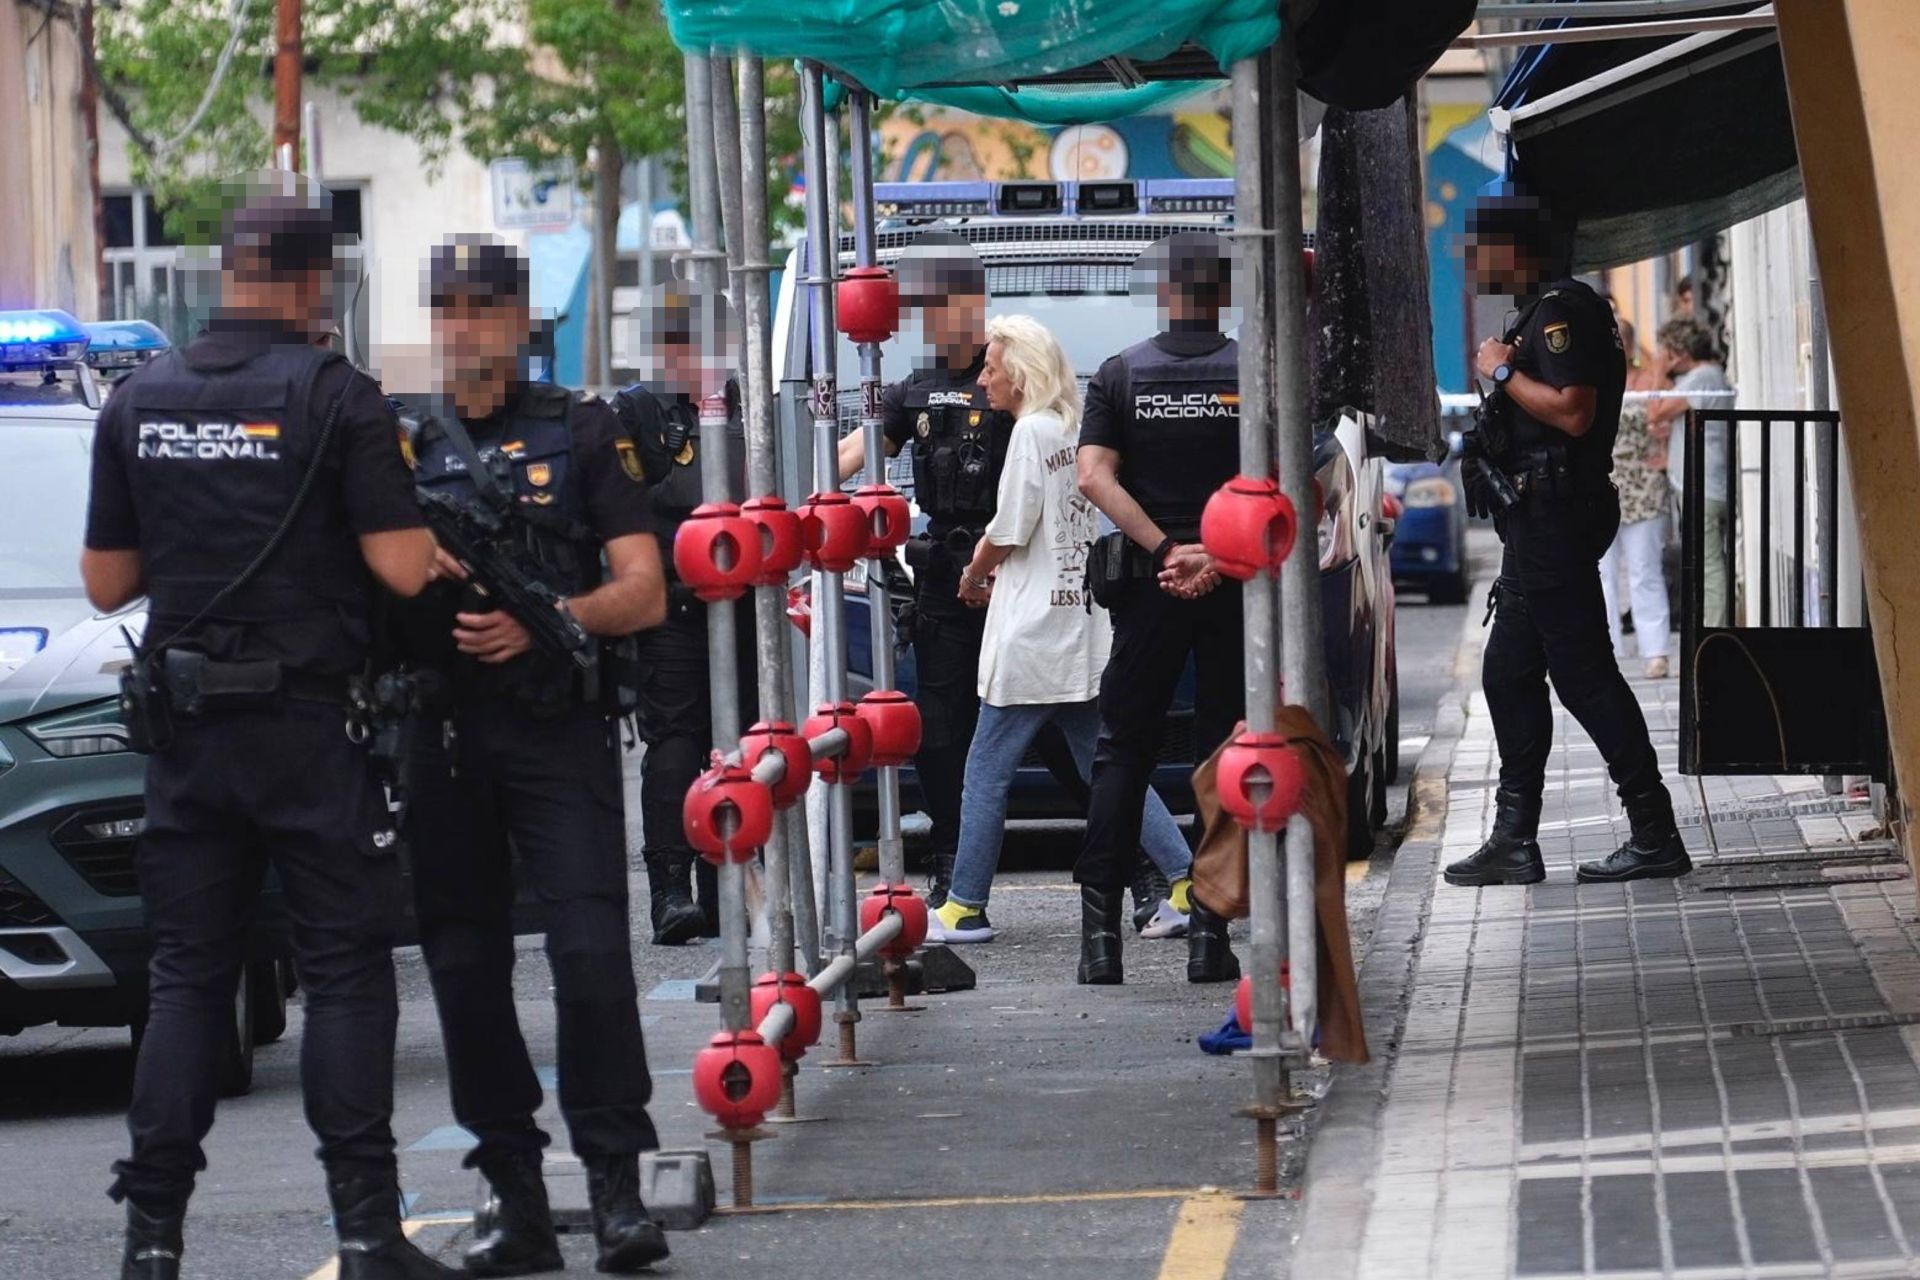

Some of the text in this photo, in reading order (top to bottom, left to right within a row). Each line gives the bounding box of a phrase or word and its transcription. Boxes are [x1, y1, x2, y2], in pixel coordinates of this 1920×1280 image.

[1135, 394, 1221, 406] POLICIA
[1135, 406, 1240, 419] NACIONAL
[139, 423, 247, 440] POLICIA
[138, 442, 280, 458] NACIONAL
[1045, 446, 1074, 475] MORE
[1050, 589, 1080, 606] LESS
